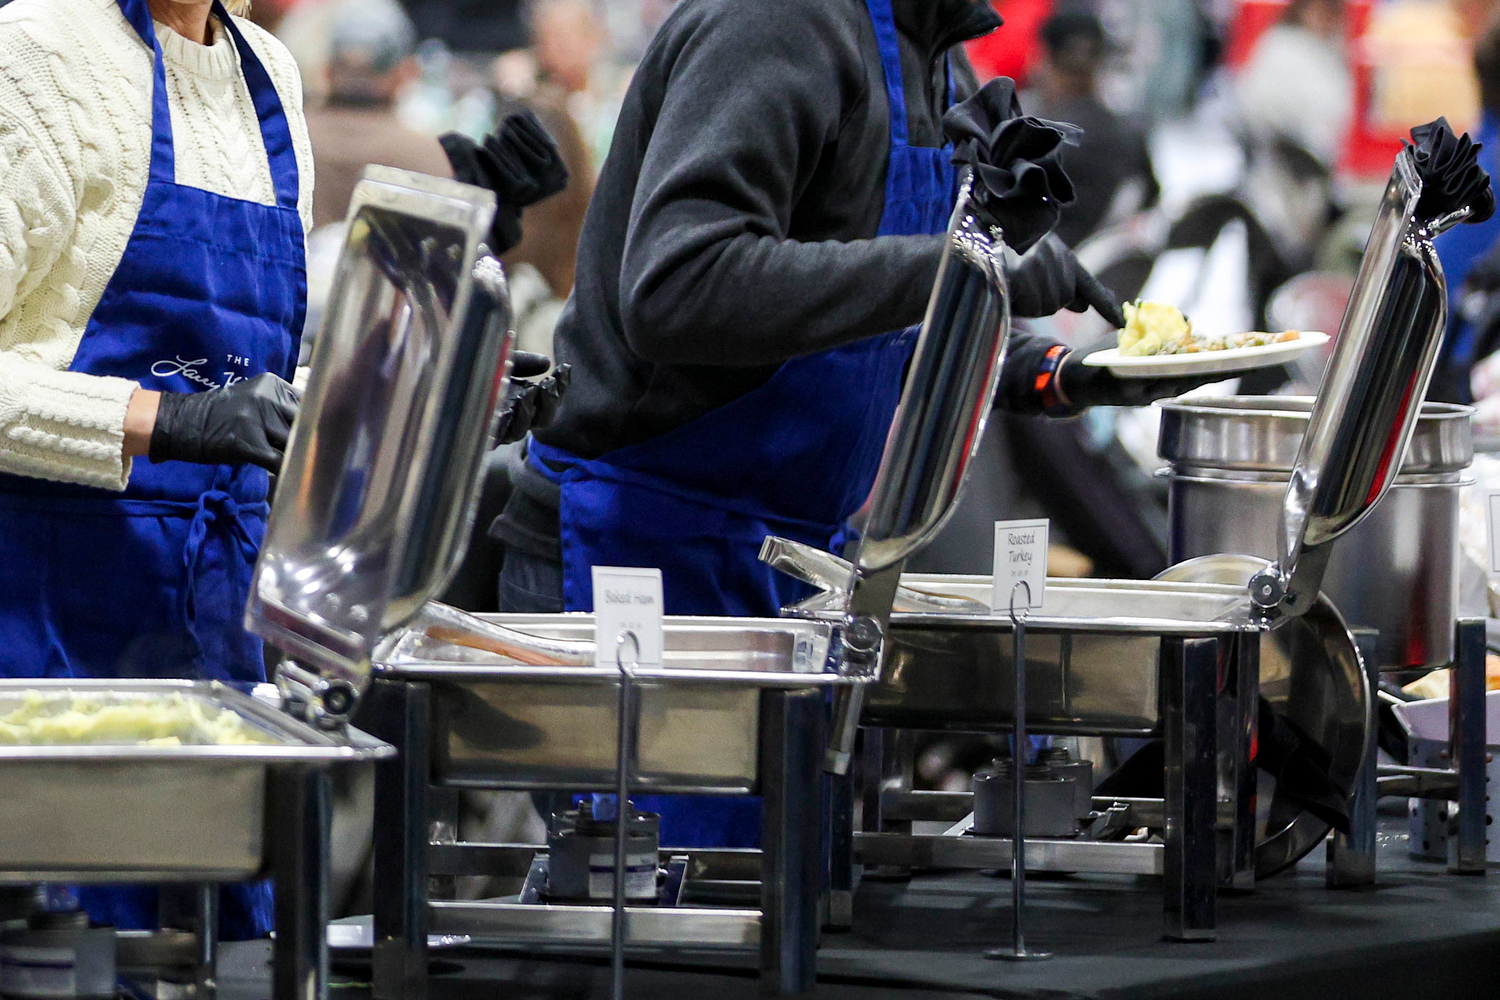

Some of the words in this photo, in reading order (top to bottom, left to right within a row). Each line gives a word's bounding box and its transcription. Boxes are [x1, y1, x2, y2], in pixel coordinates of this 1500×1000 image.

[226, 354, 250, 367] THE
[1008, 530, 1035, 546] Roasted
[1008, 549, 1033, 567] Turkey
